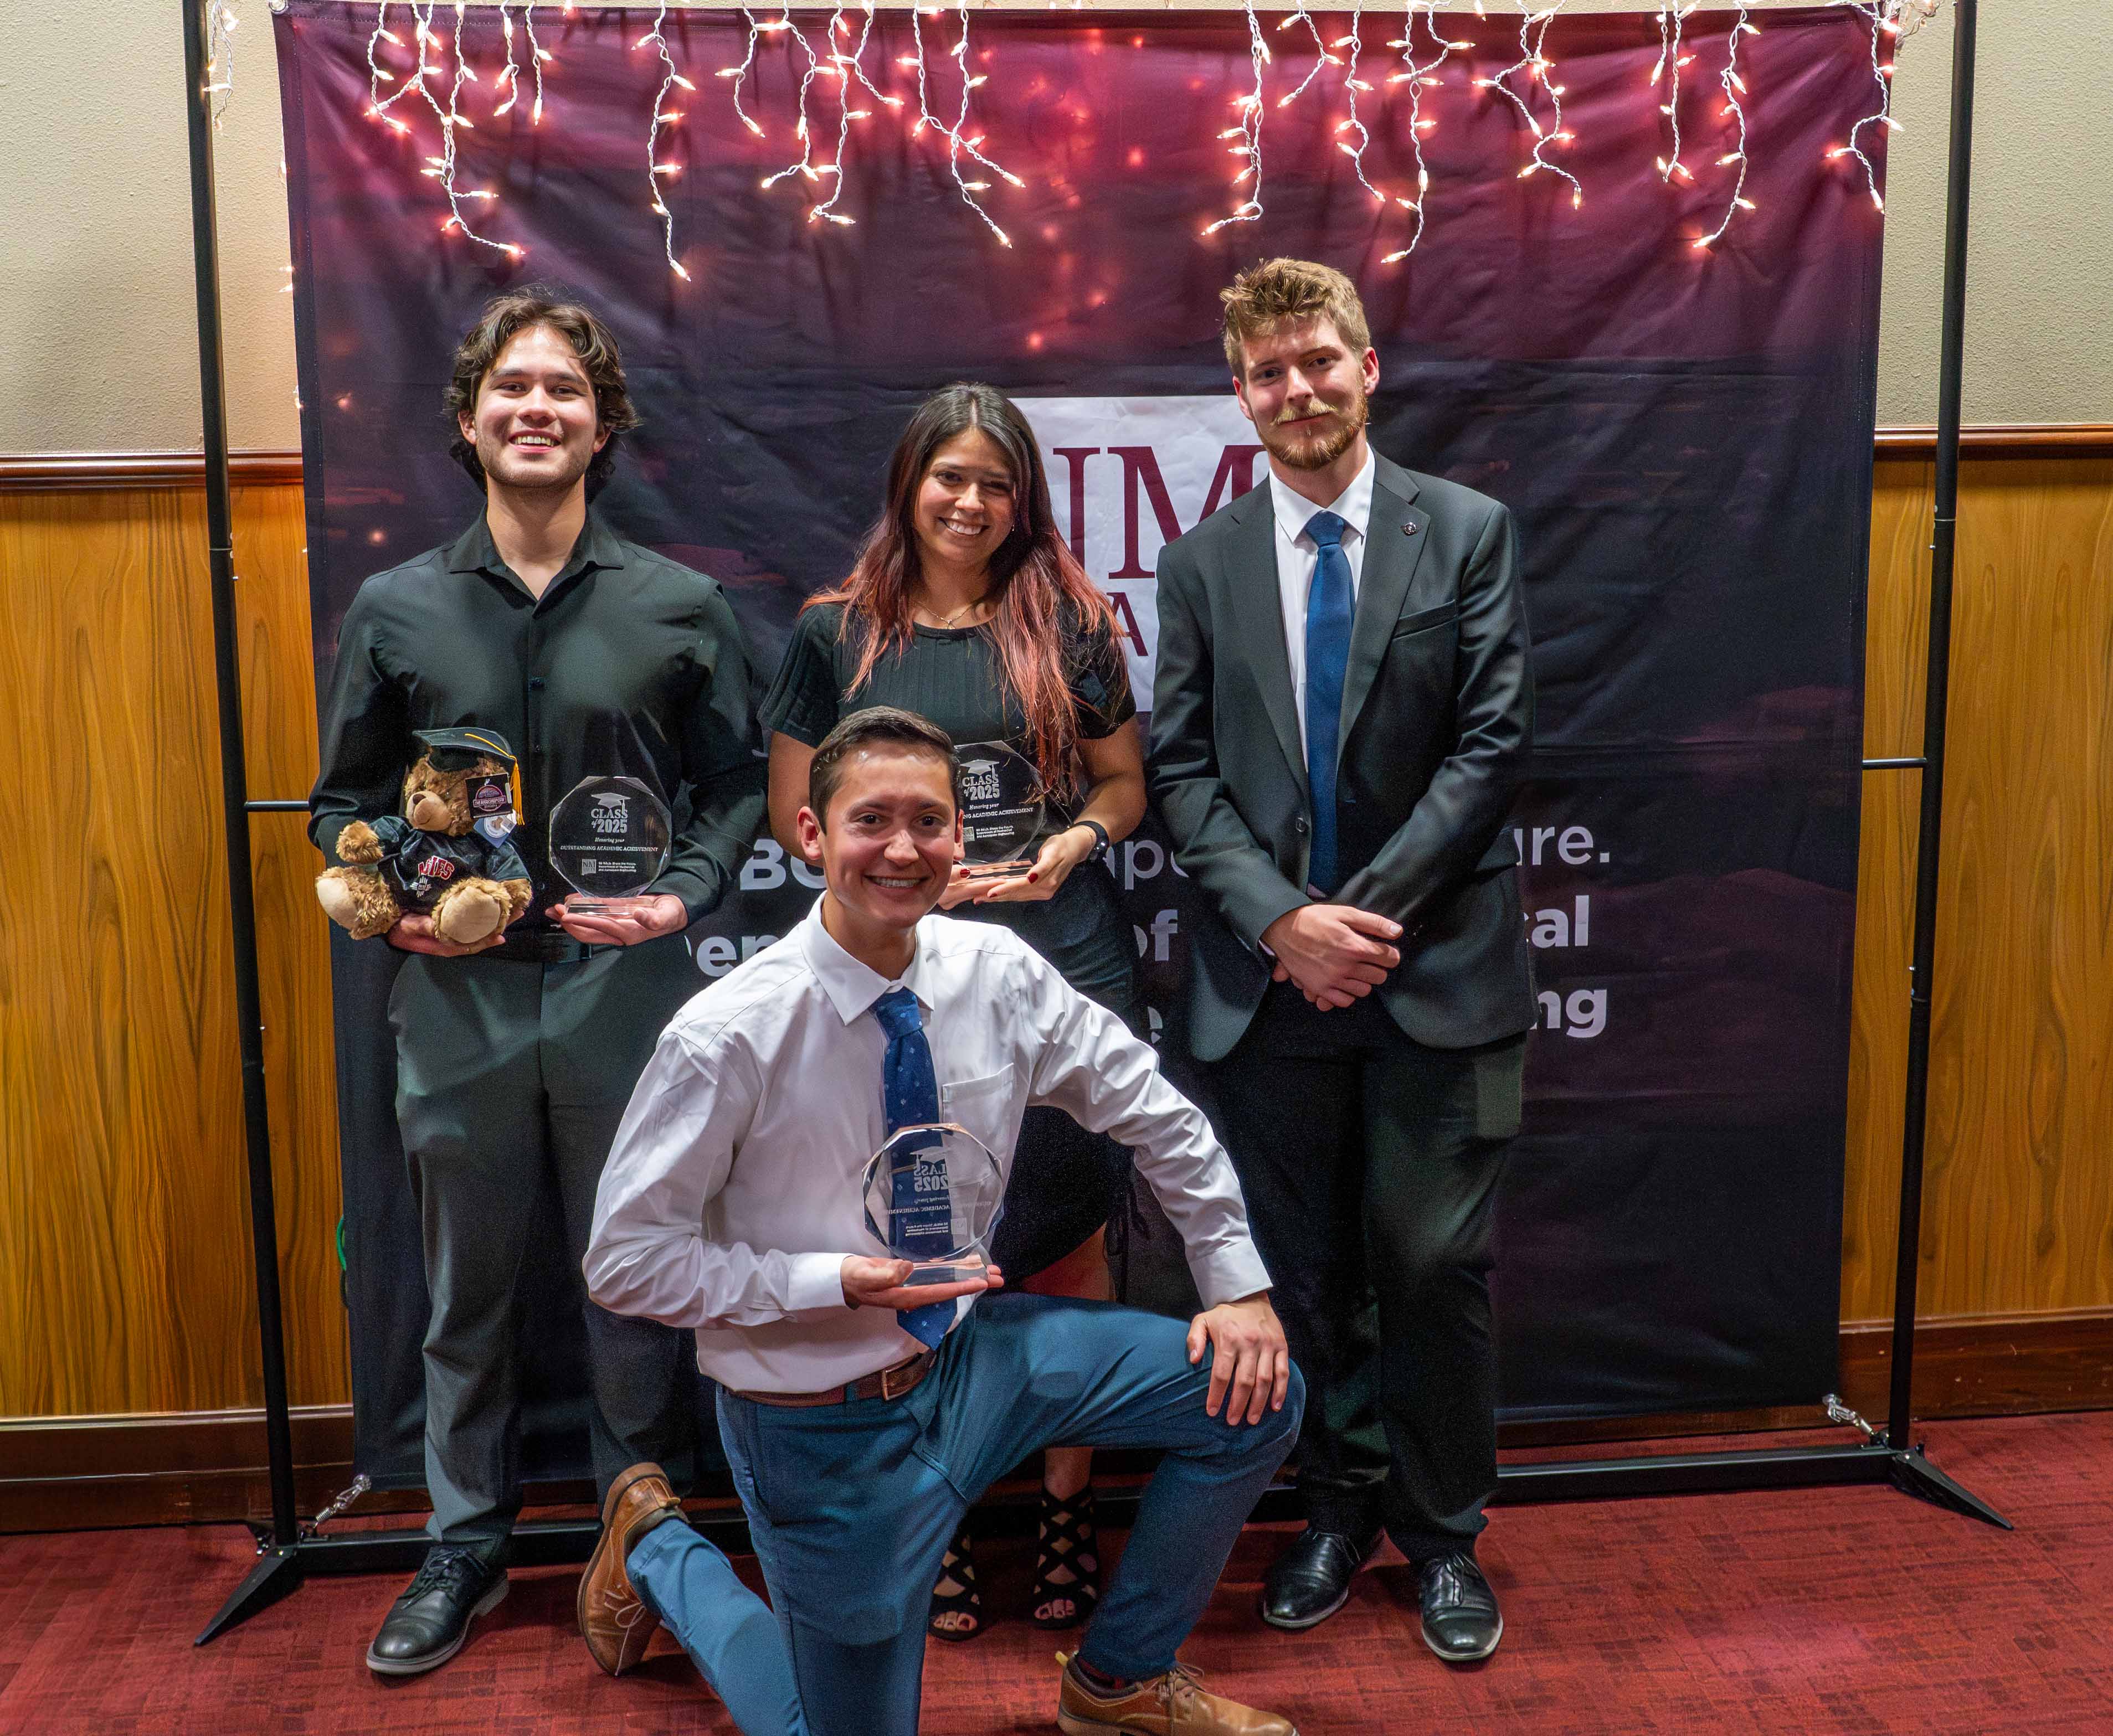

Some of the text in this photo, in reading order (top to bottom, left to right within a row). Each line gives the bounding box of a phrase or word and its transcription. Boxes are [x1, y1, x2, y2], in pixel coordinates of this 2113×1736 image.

[962, 772, 999, 787] CLASS
[970, 784, 1000, 801] 2025
[590, 808, 629, 819] CLASS
[972, 810, 999, 819] ACADEMIC
[998, 807, 1034, 817] ACHIEVEMENT
[597, 818, 628, 833] 2025
